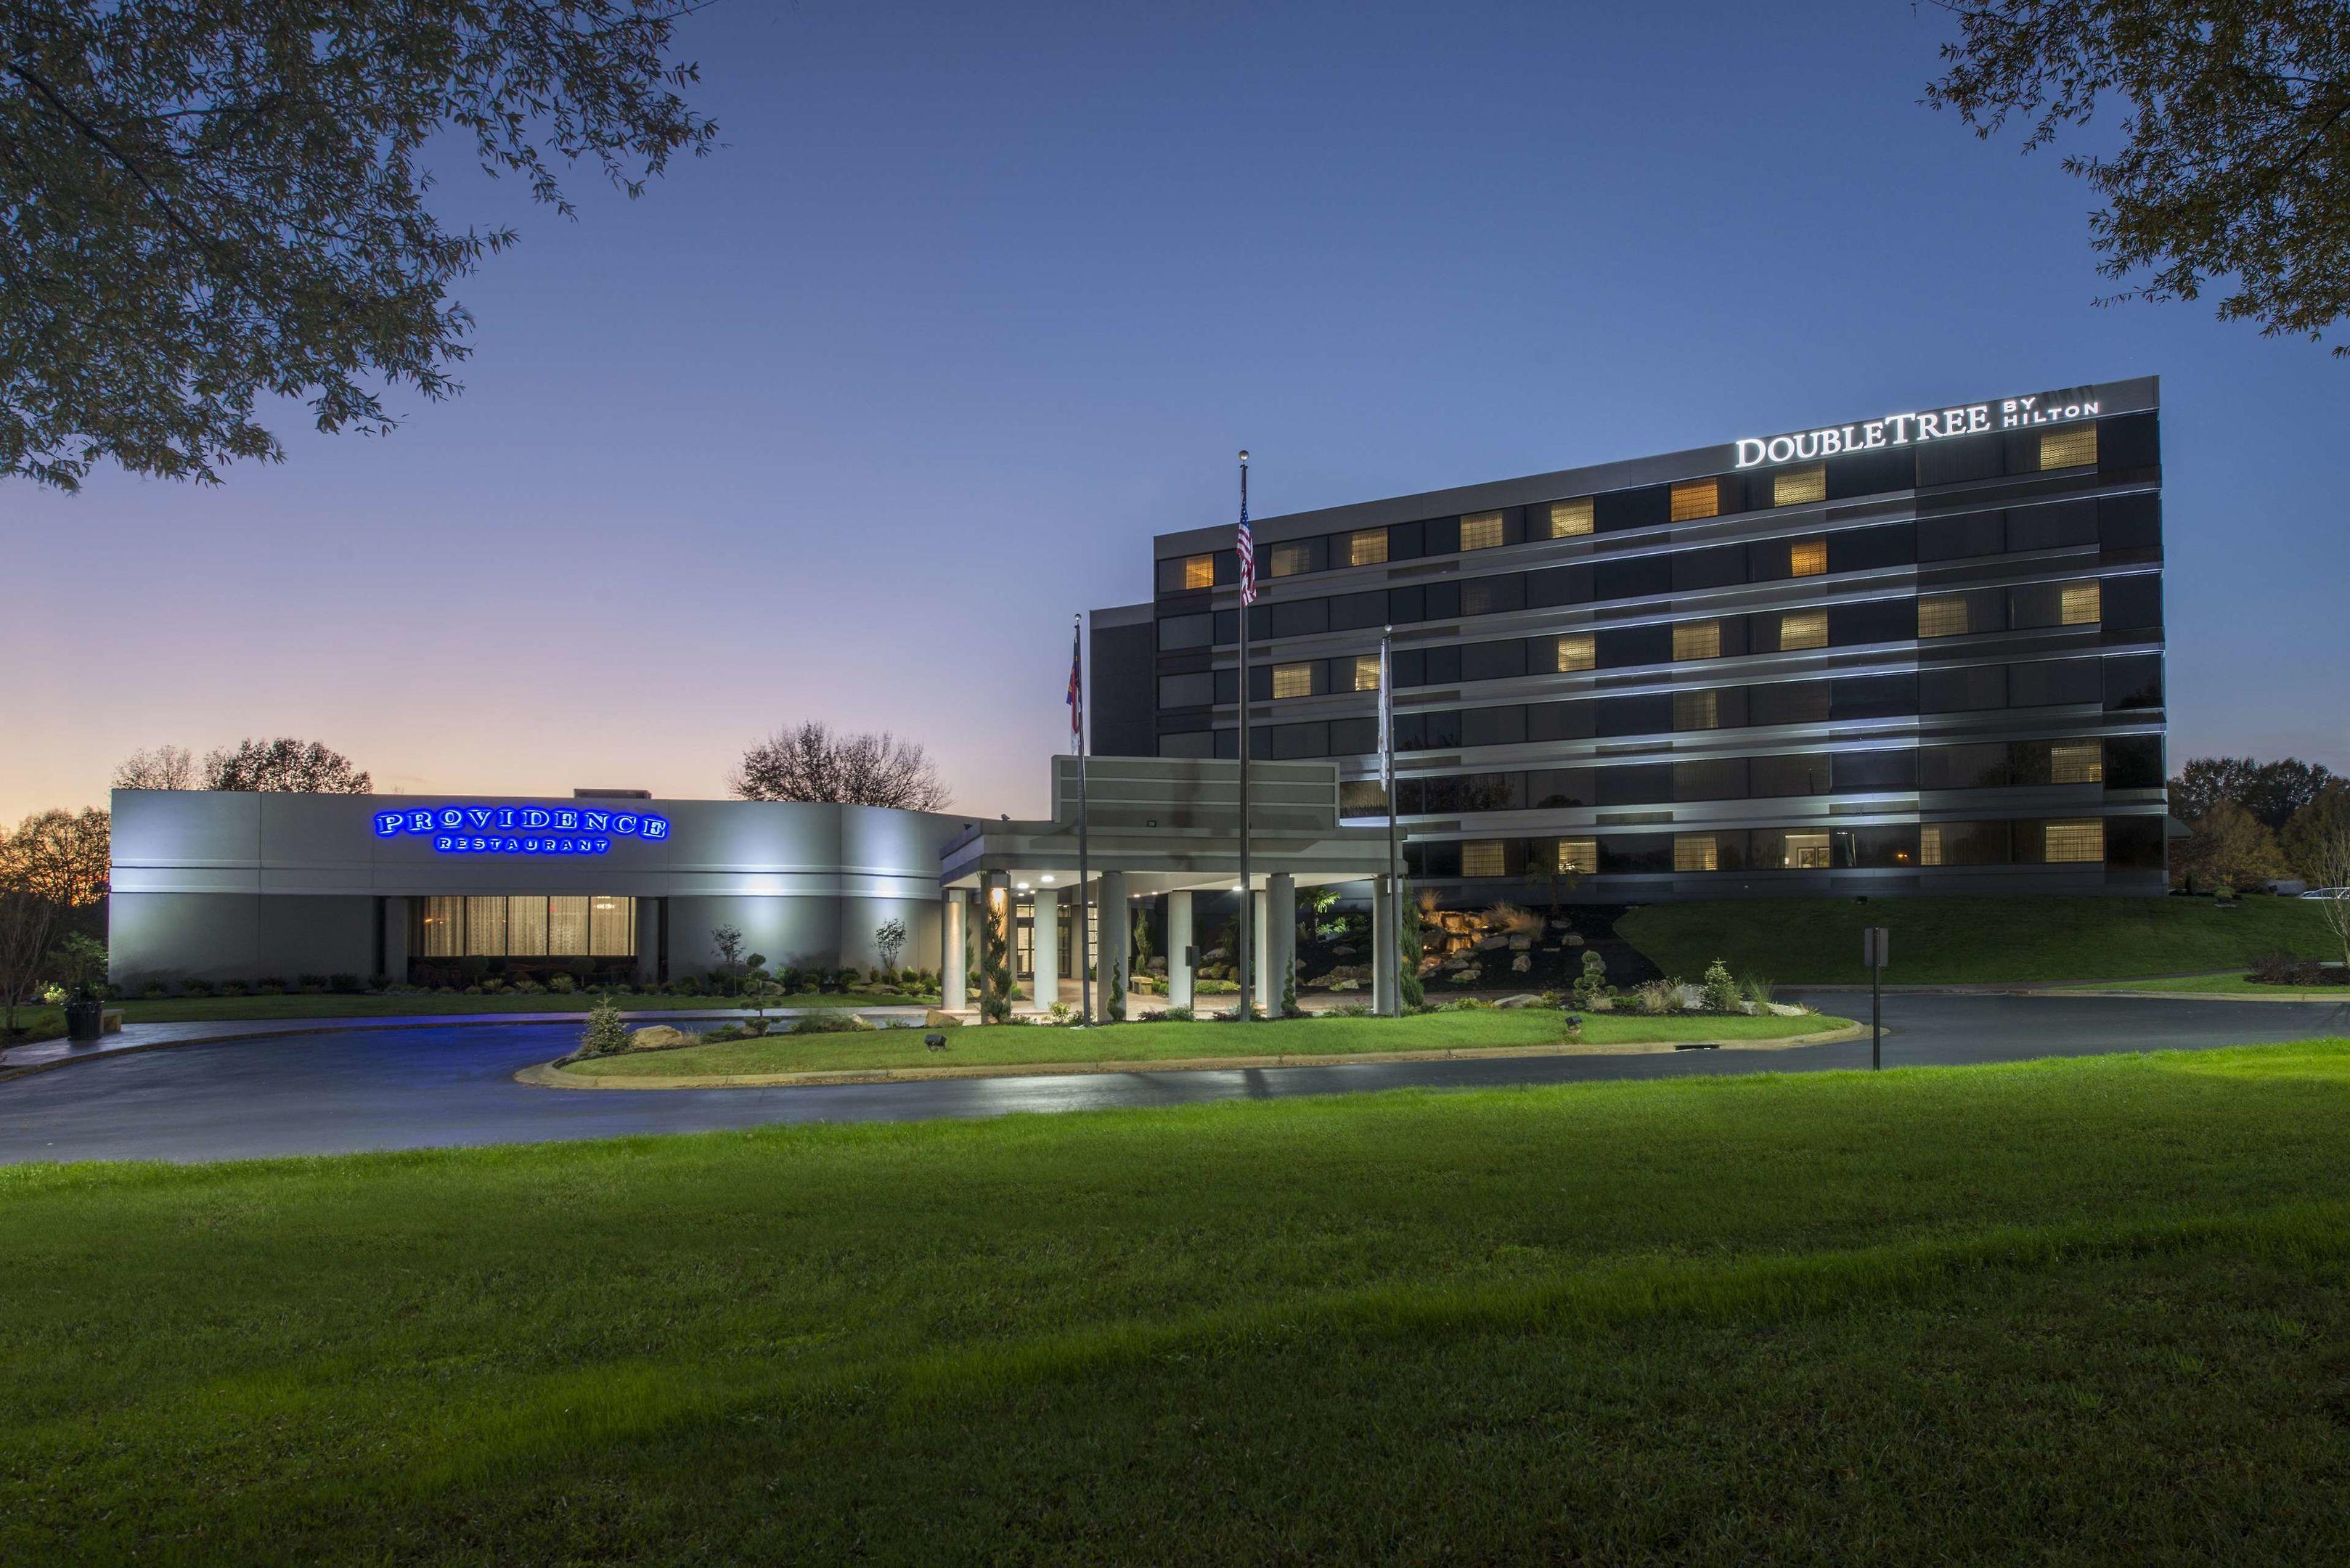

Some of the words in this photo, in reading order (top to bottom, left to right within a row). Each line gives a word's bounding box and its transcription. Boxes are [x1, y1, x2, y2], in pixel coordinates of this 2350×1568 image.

[2003, 397, 2036, 413] BY
[2004, 401, 2100, 428] HILTON
[377, 808, 667, 838] PROVIDENCE
[438, 837, 609, 852] RESTAURANT
